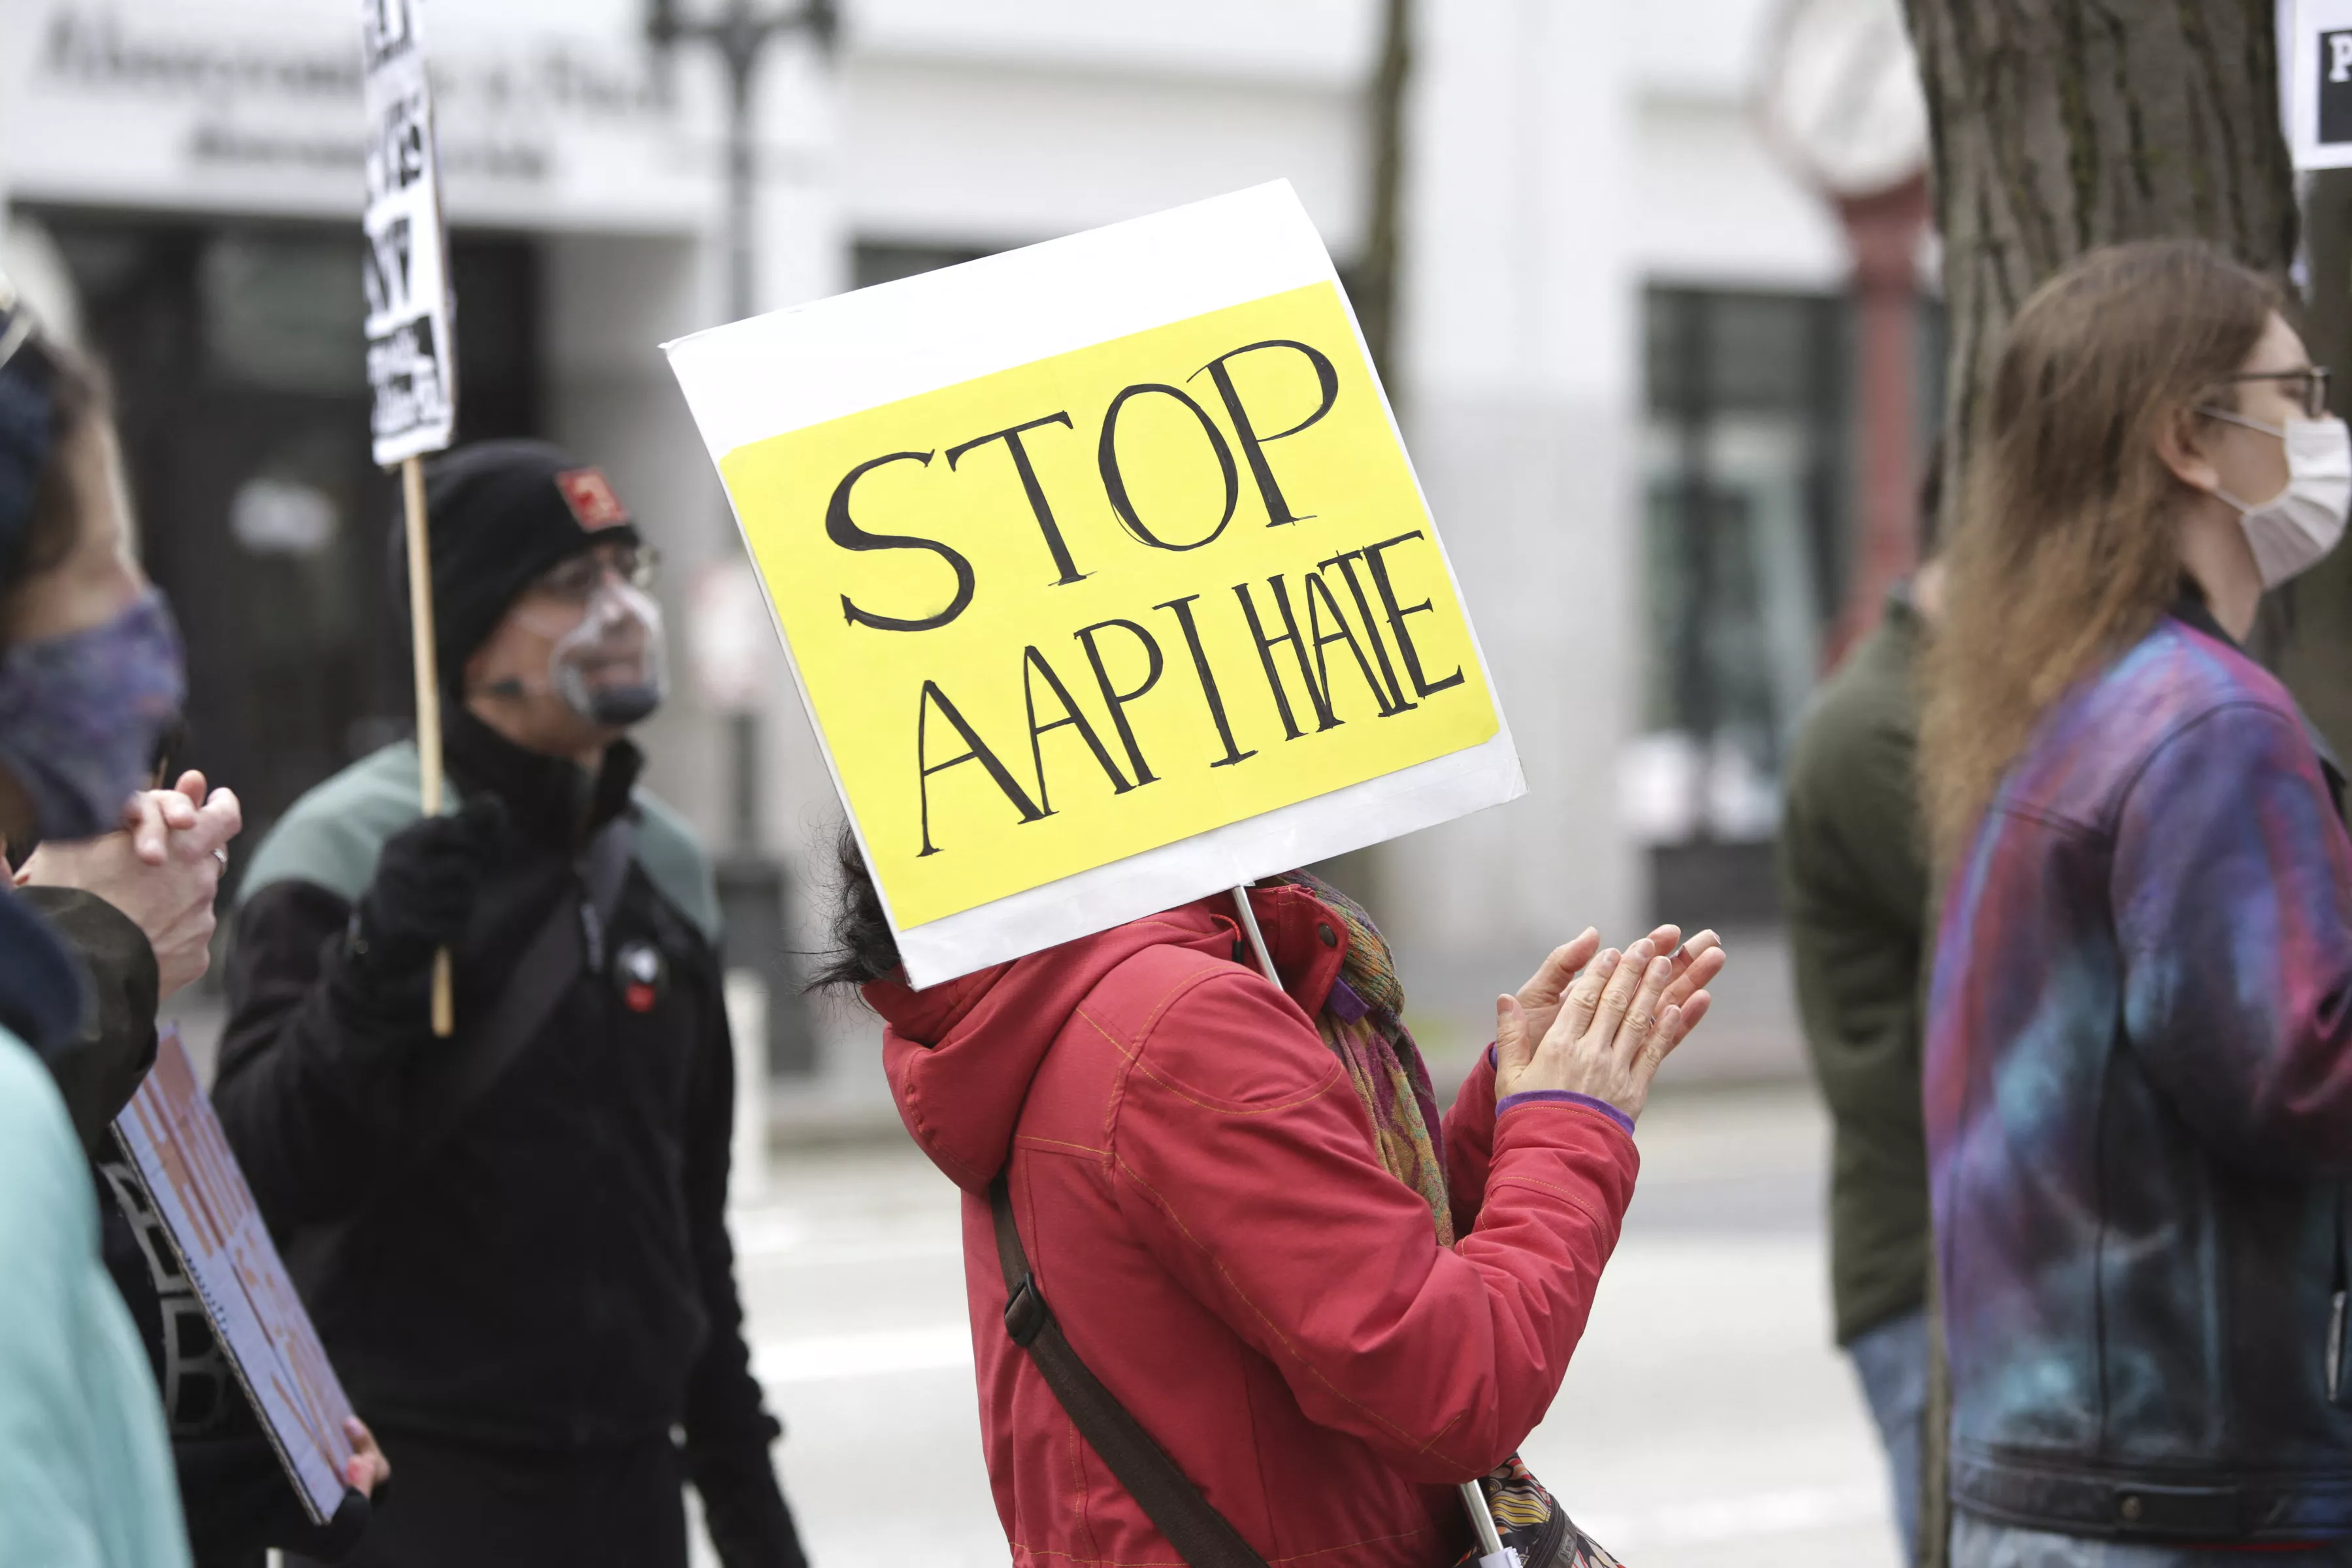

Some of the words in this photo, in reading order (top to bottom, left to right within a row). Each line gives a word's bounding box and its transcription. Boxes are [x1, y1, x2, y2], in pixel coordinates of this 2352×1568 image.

[825, 339, 1339, 632] STOP
[916, 593, 1259, 858] AAPI
[1232, 529, 1465, 742] HATE
